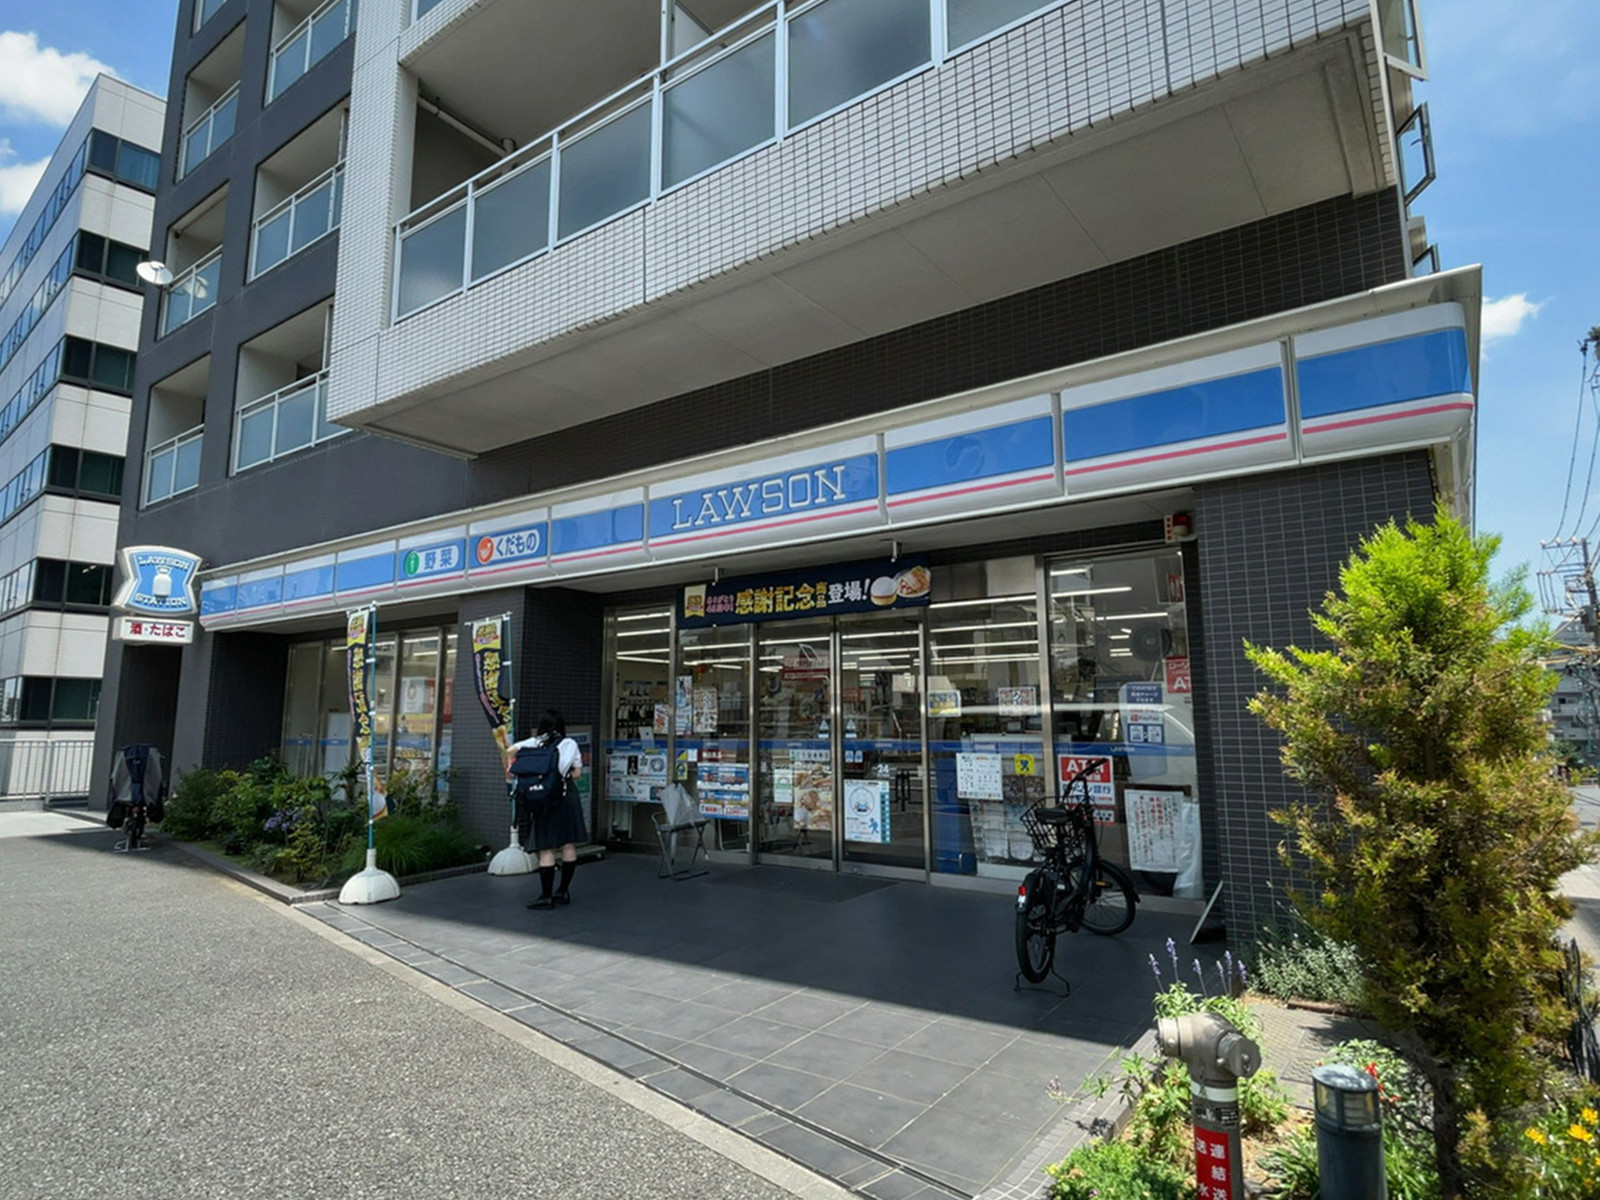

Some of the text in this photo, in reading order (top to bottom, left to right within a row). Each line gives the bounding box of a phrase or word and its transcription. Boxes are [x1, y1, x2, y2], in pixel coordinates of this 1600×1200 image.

[673, 465, 845, 529] LAWSON
[496, 532, 537, 557] くだもの
[138, 555, 189, 570] LAWSON
[424, 548, 452, 570] 野菜
[135, 593, 187, 606] STATION
